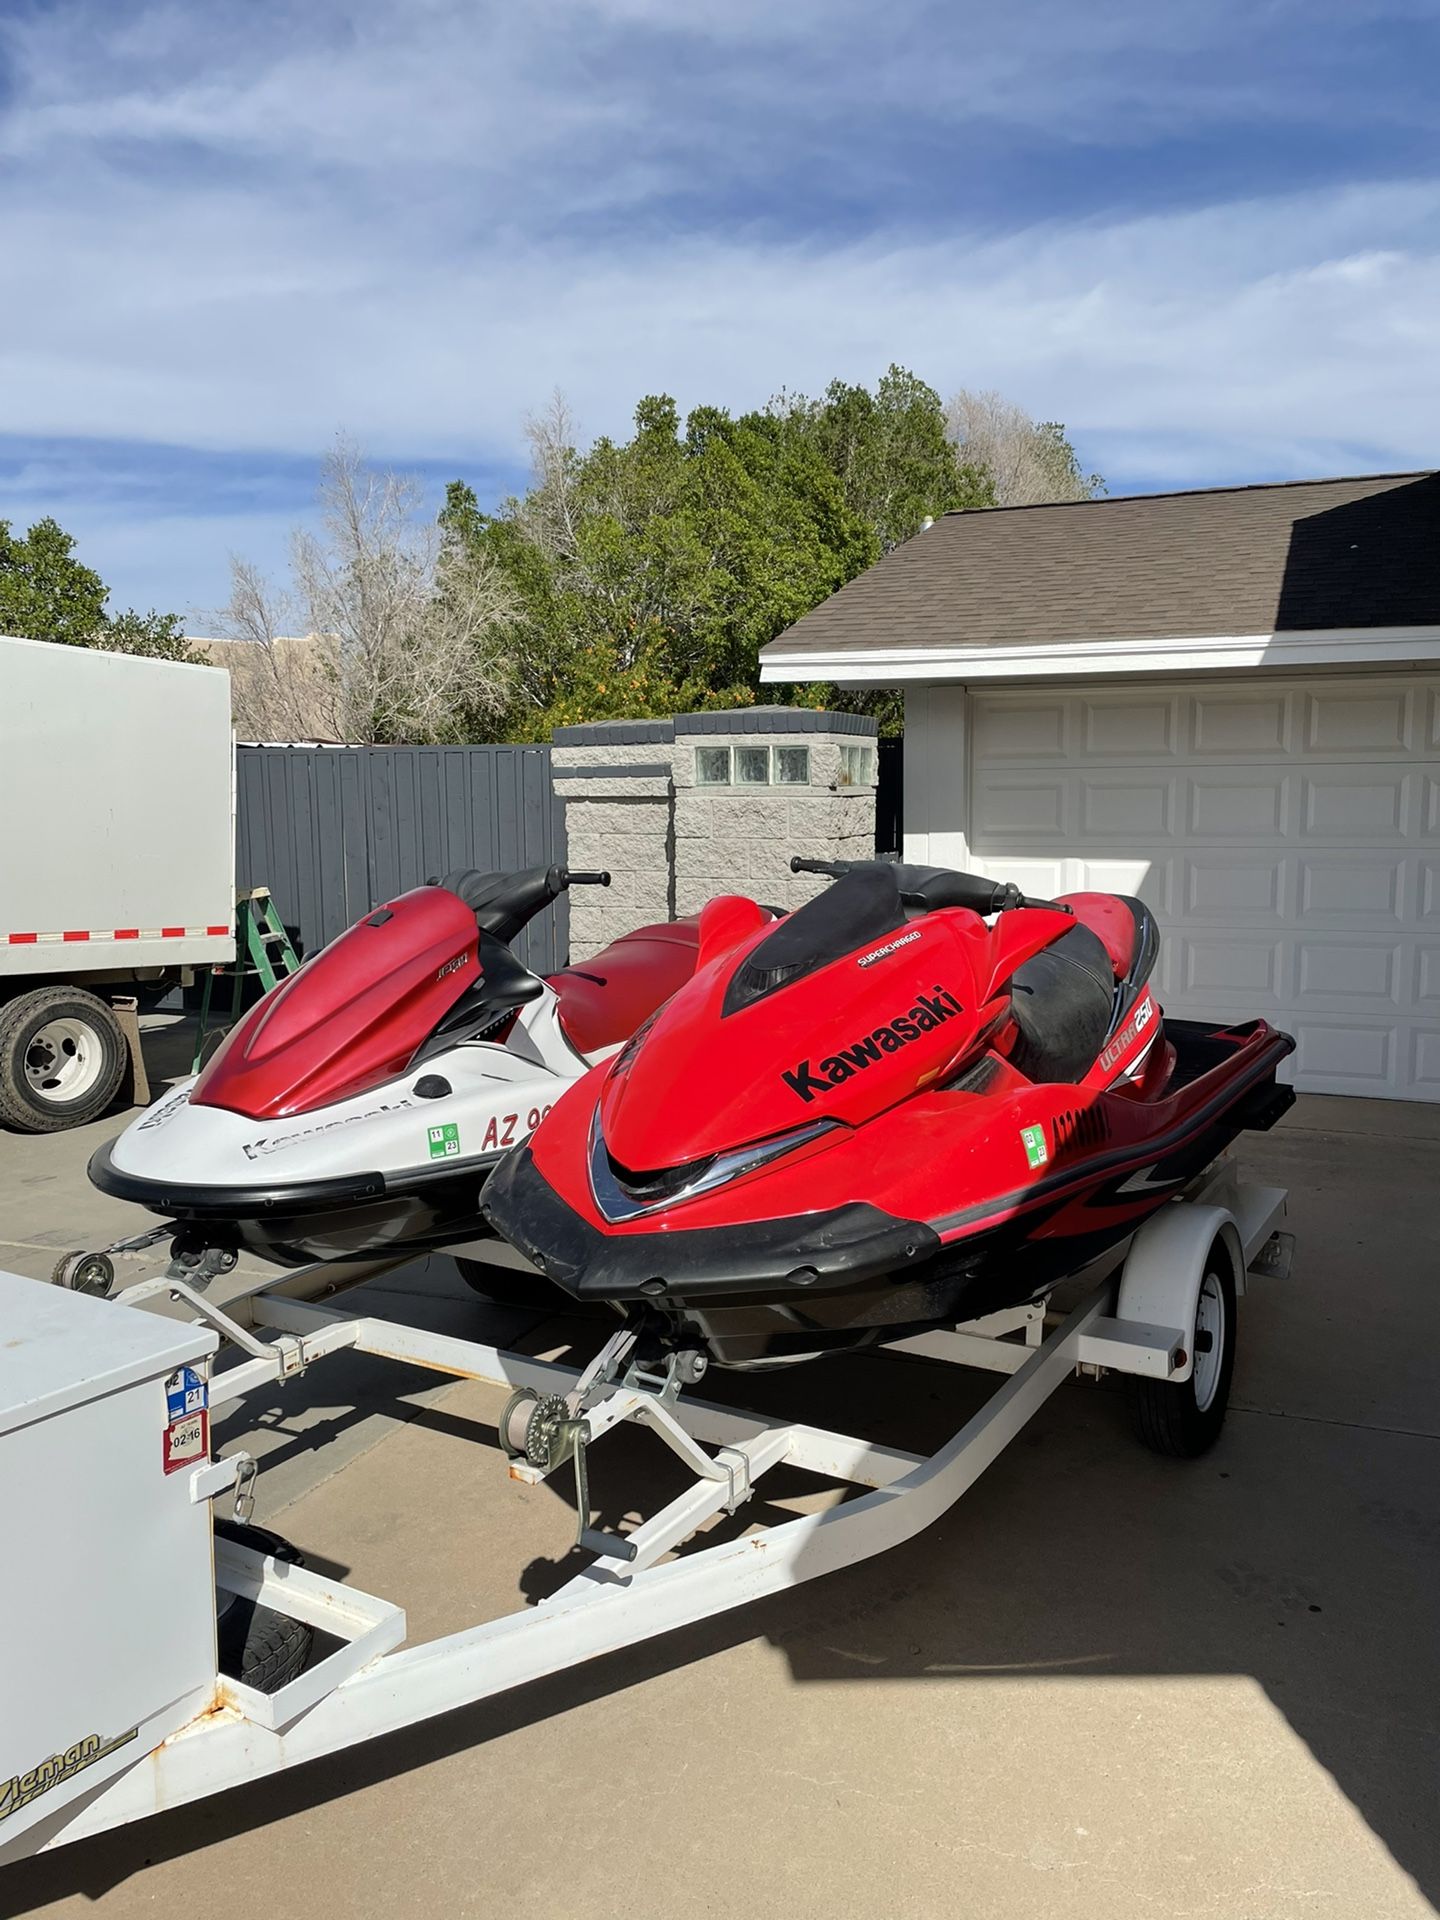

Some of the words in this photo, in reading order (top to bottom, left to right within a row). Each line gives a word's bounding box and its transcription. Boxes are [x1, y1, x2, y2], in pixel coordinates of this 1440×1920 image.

[857, 930, 922, 967] SUPERCHARGED
[780, 985, 965, 1104] Kawasaki
[1100, 1020, 1139, 1072] ULTRA
[1134, 996, 1153, 1032] 250
[447, 1142, 456, 1150] 23
[481, 1113, 519, 1151] AZ
[187, 1389, 200, 1403] 21
